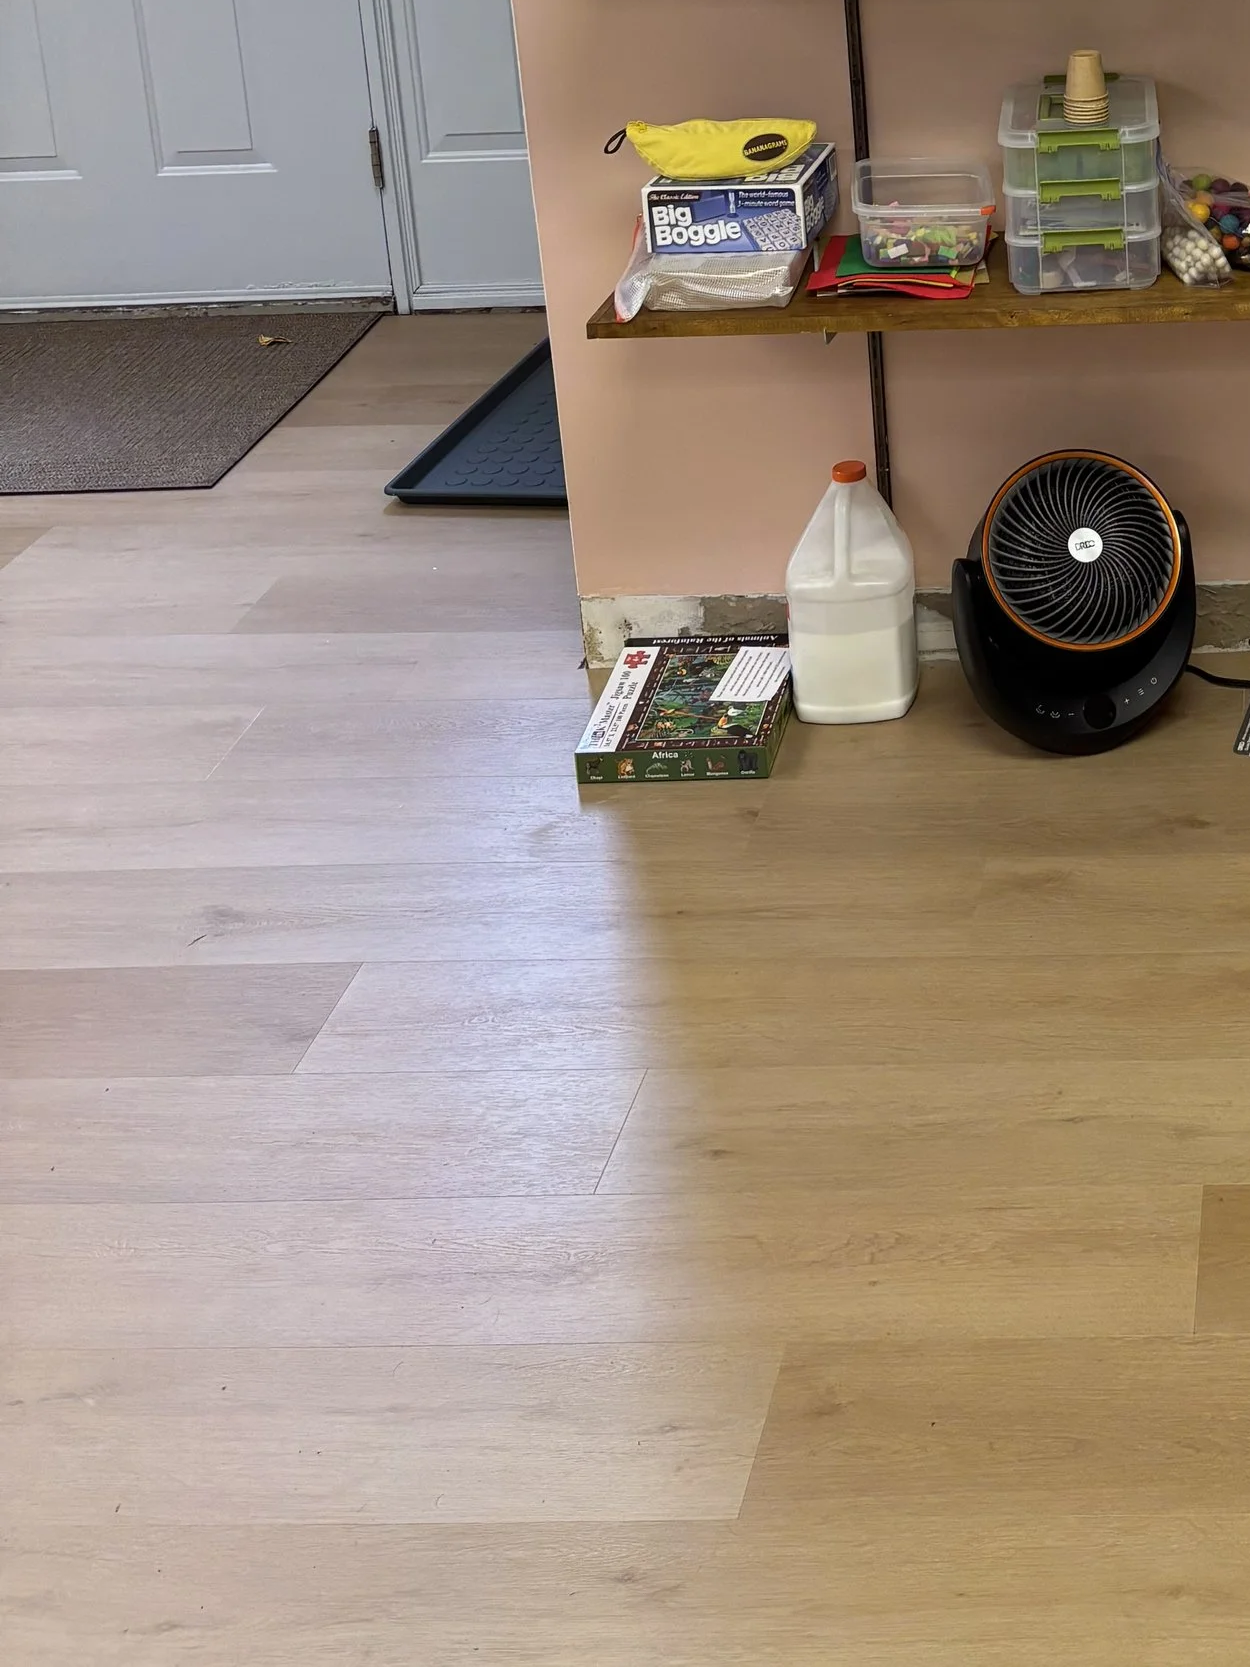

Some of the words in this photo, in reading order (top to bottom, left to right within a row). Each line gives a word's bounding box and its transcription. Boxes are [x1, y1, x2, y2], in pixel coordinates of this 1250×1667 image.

[744, 138, 788, 157] BANANAGRAMS
[652, 204, 692, 226] Big
[655, 220, 741, 246] Boggle
[610, 682, 626, 700] Jigsaw
[620, 670, 632, 680] 100
[622, 682, 638, 700] Puzzle
[652, 750, 678, 760] Africa
